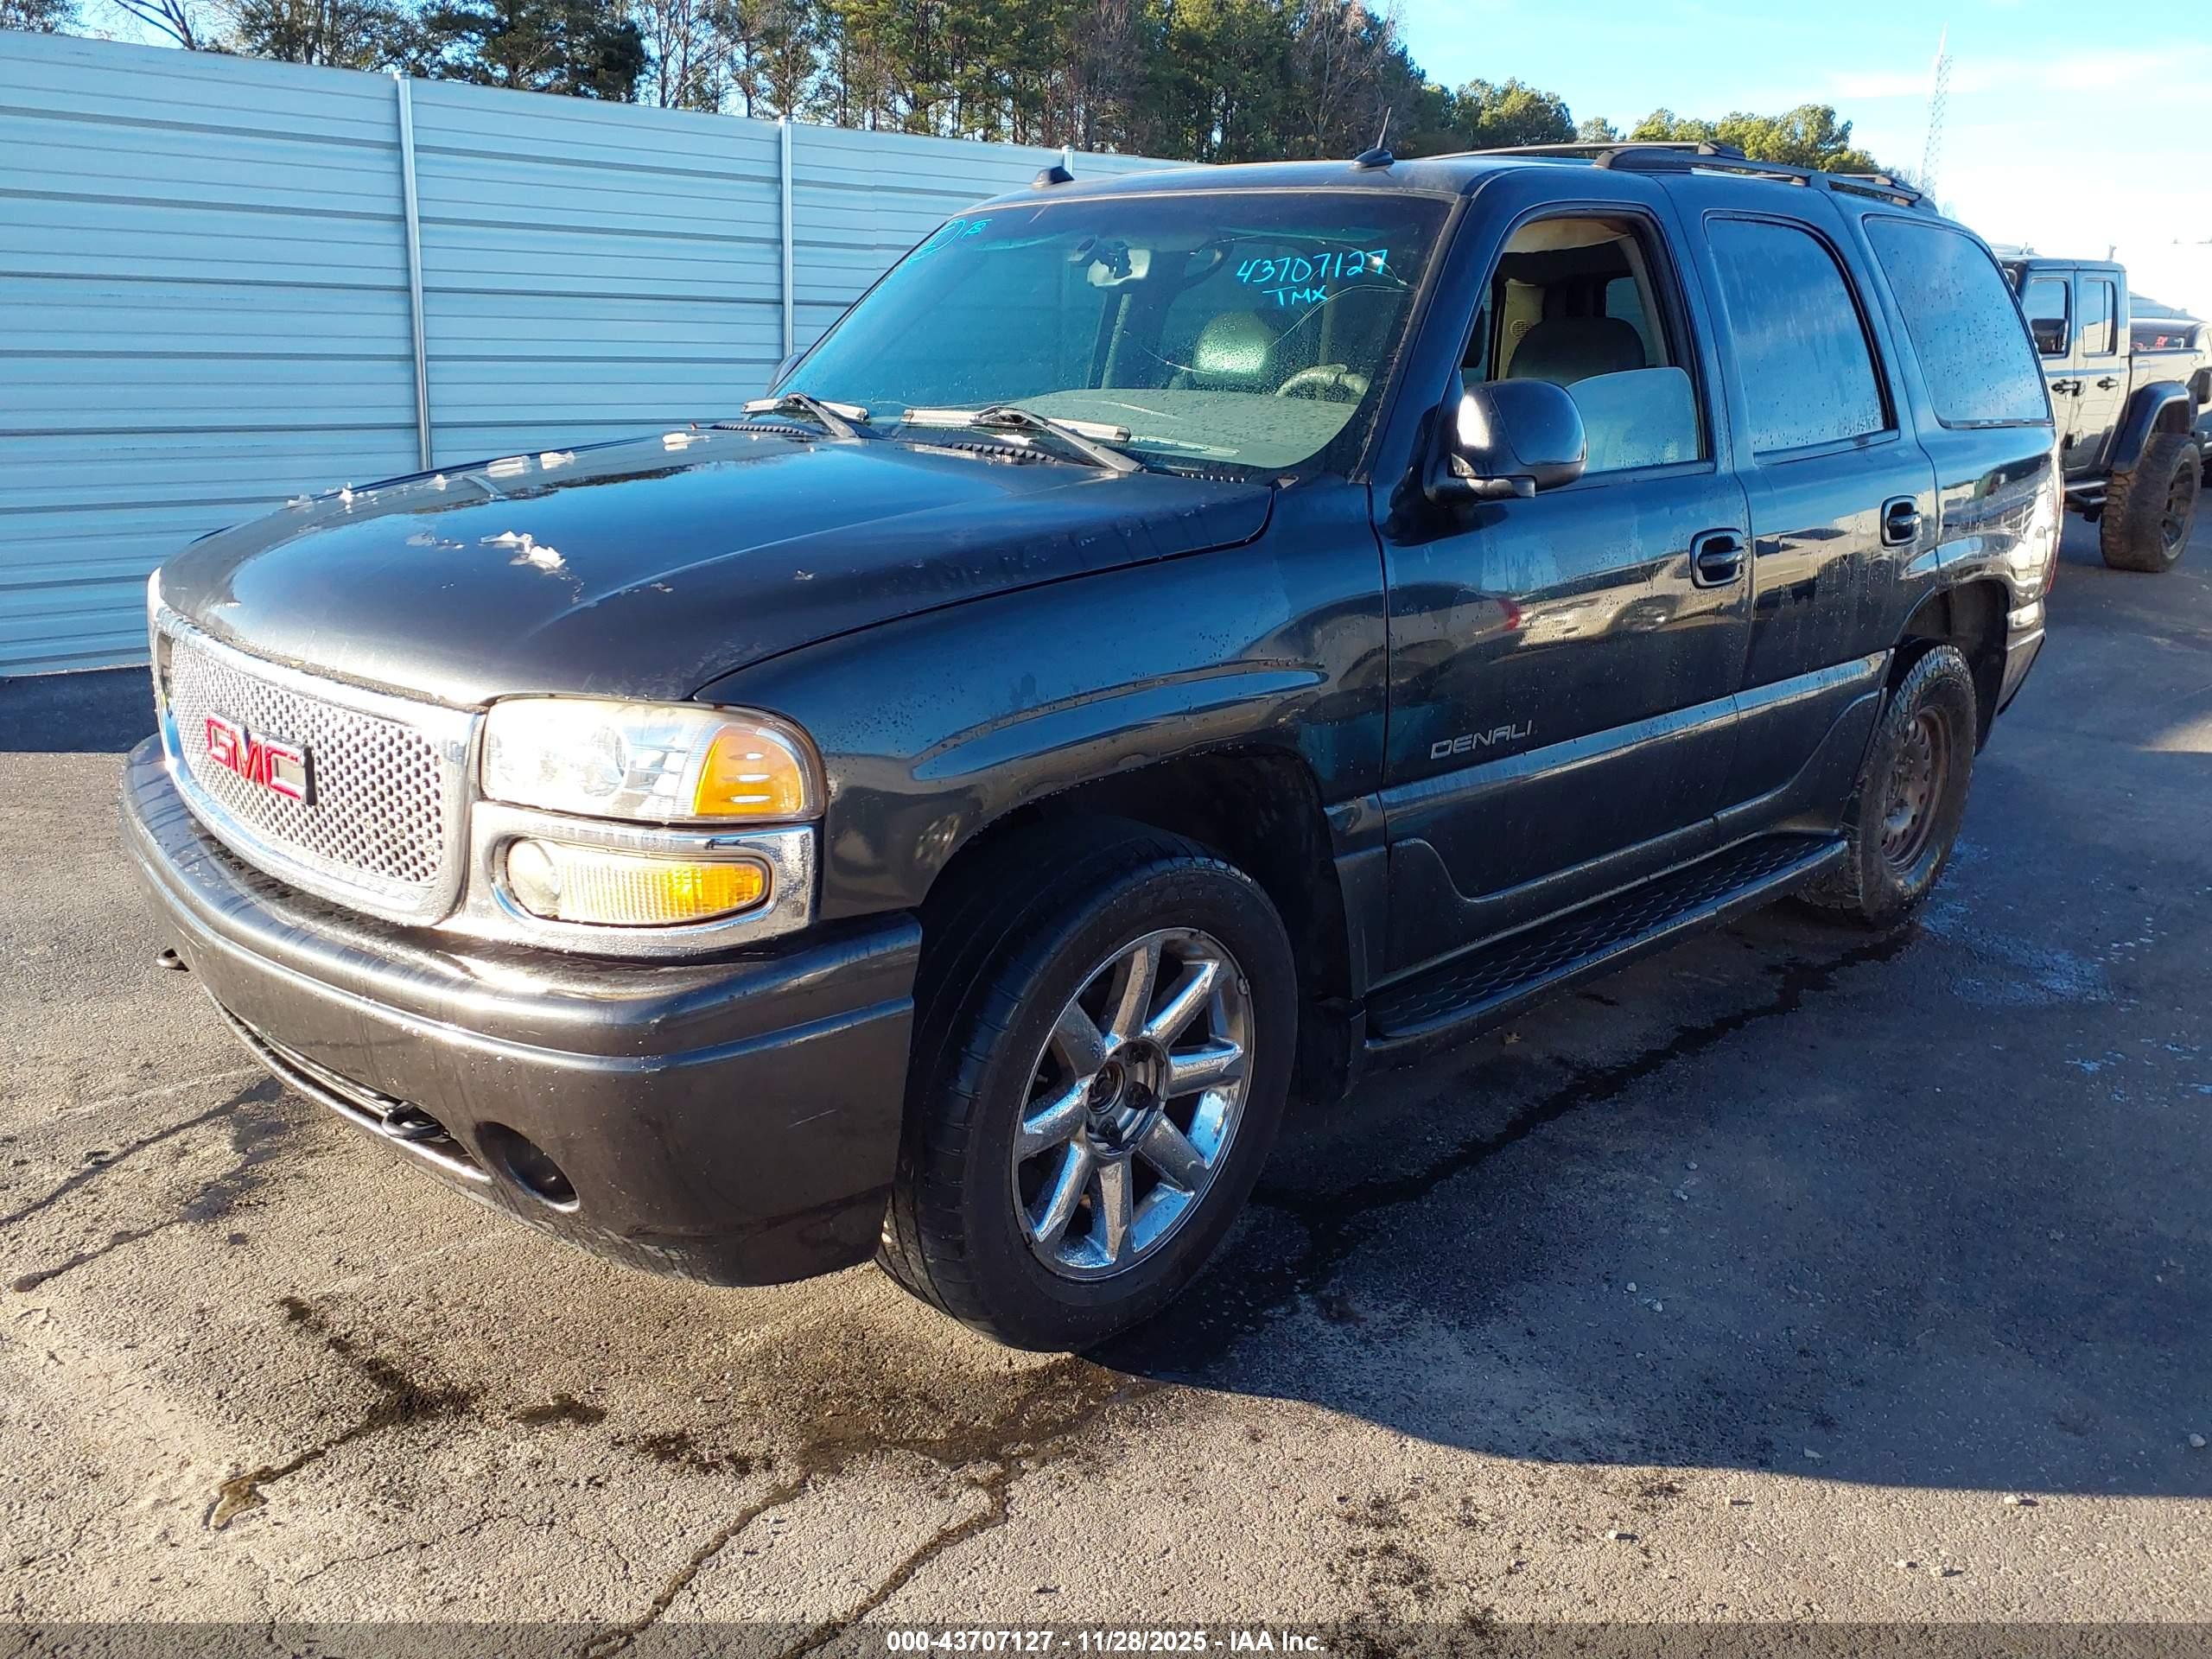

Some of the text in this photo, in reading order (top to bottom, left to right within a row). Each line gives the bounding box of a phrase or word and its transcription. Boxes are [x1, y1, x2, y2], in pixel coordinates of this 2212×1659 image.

[1237, 250, 1388, 283] 43707127
[1262, 285, 1327, 306] TMX
[206, 713, 305, 801] GMC
[1431, 719, 1533, 760] DENALI
